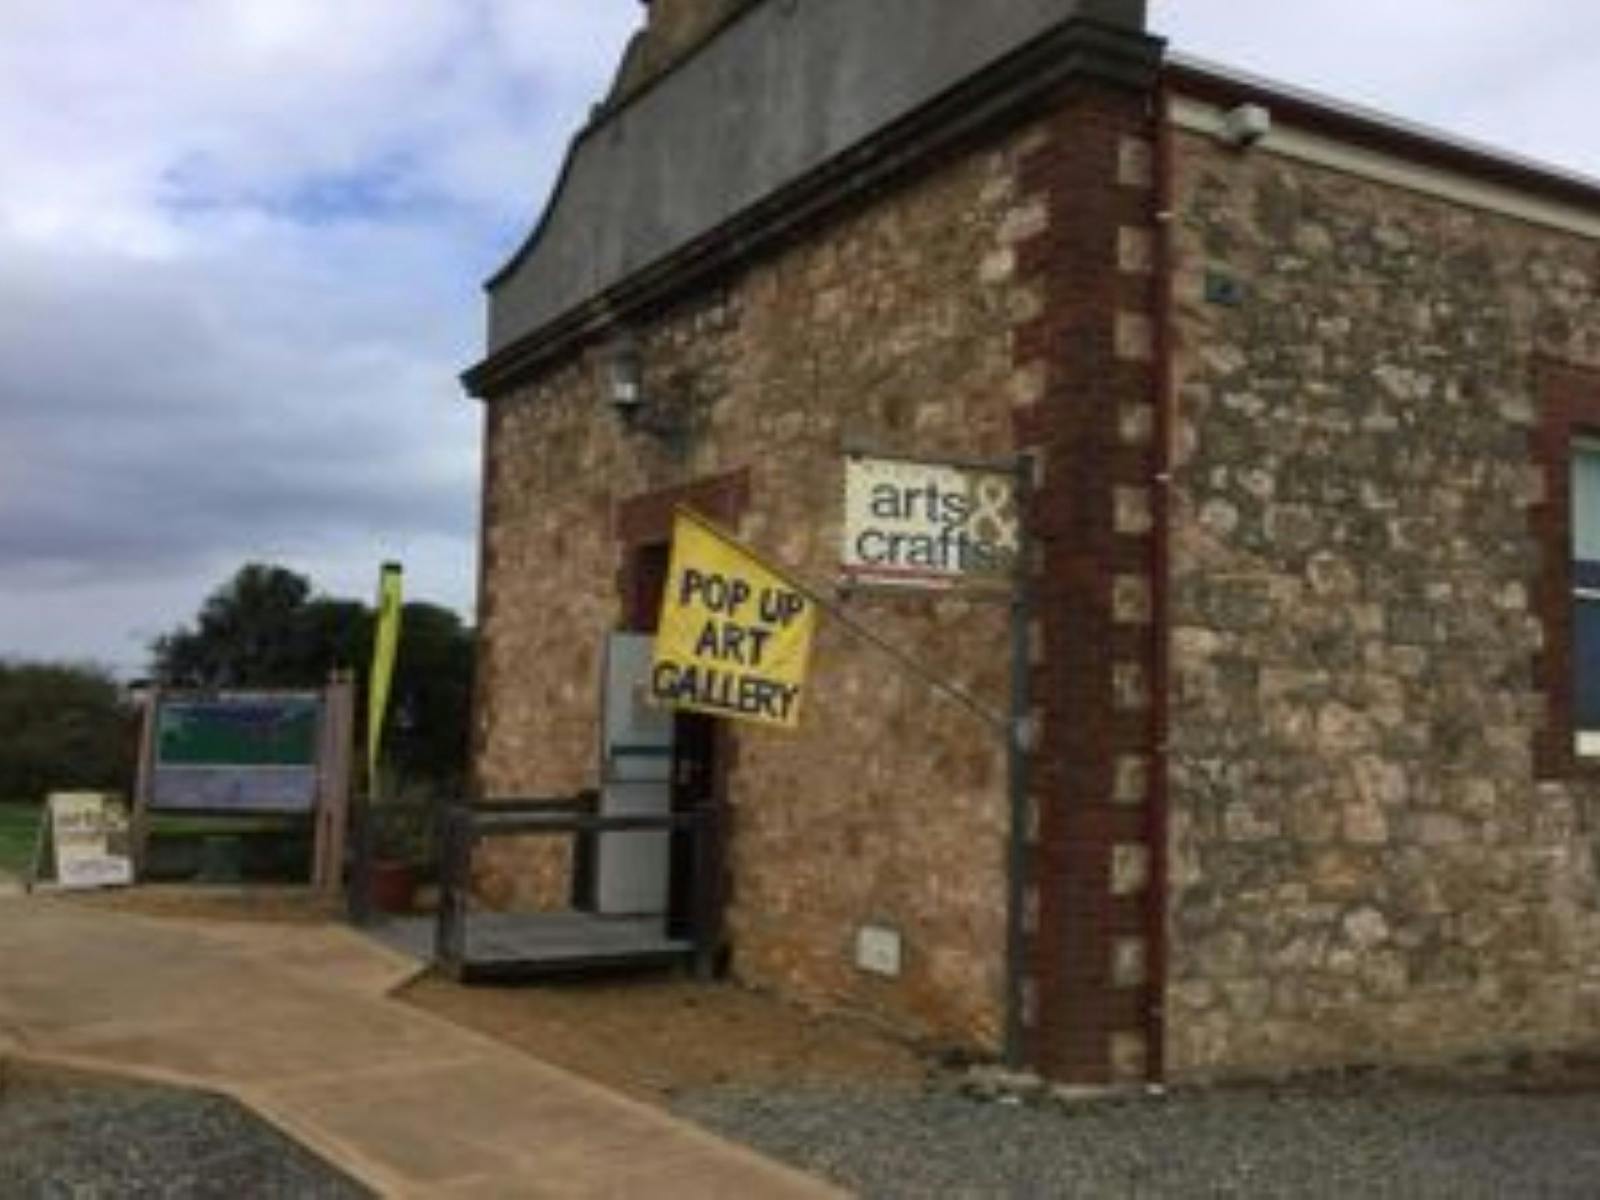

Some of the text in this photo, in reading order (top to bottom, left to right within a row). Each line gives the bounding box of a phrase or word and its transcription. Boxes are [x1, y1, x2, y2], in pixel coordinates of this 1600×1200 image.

[871, 476, 1017, 551] arts &
[856, 529, 1000, 570] crafts
[680, 568, 803, 626] POP UP
[695, 620, 771, 666] ART
[653, 660, 799, 718] GALLERY
